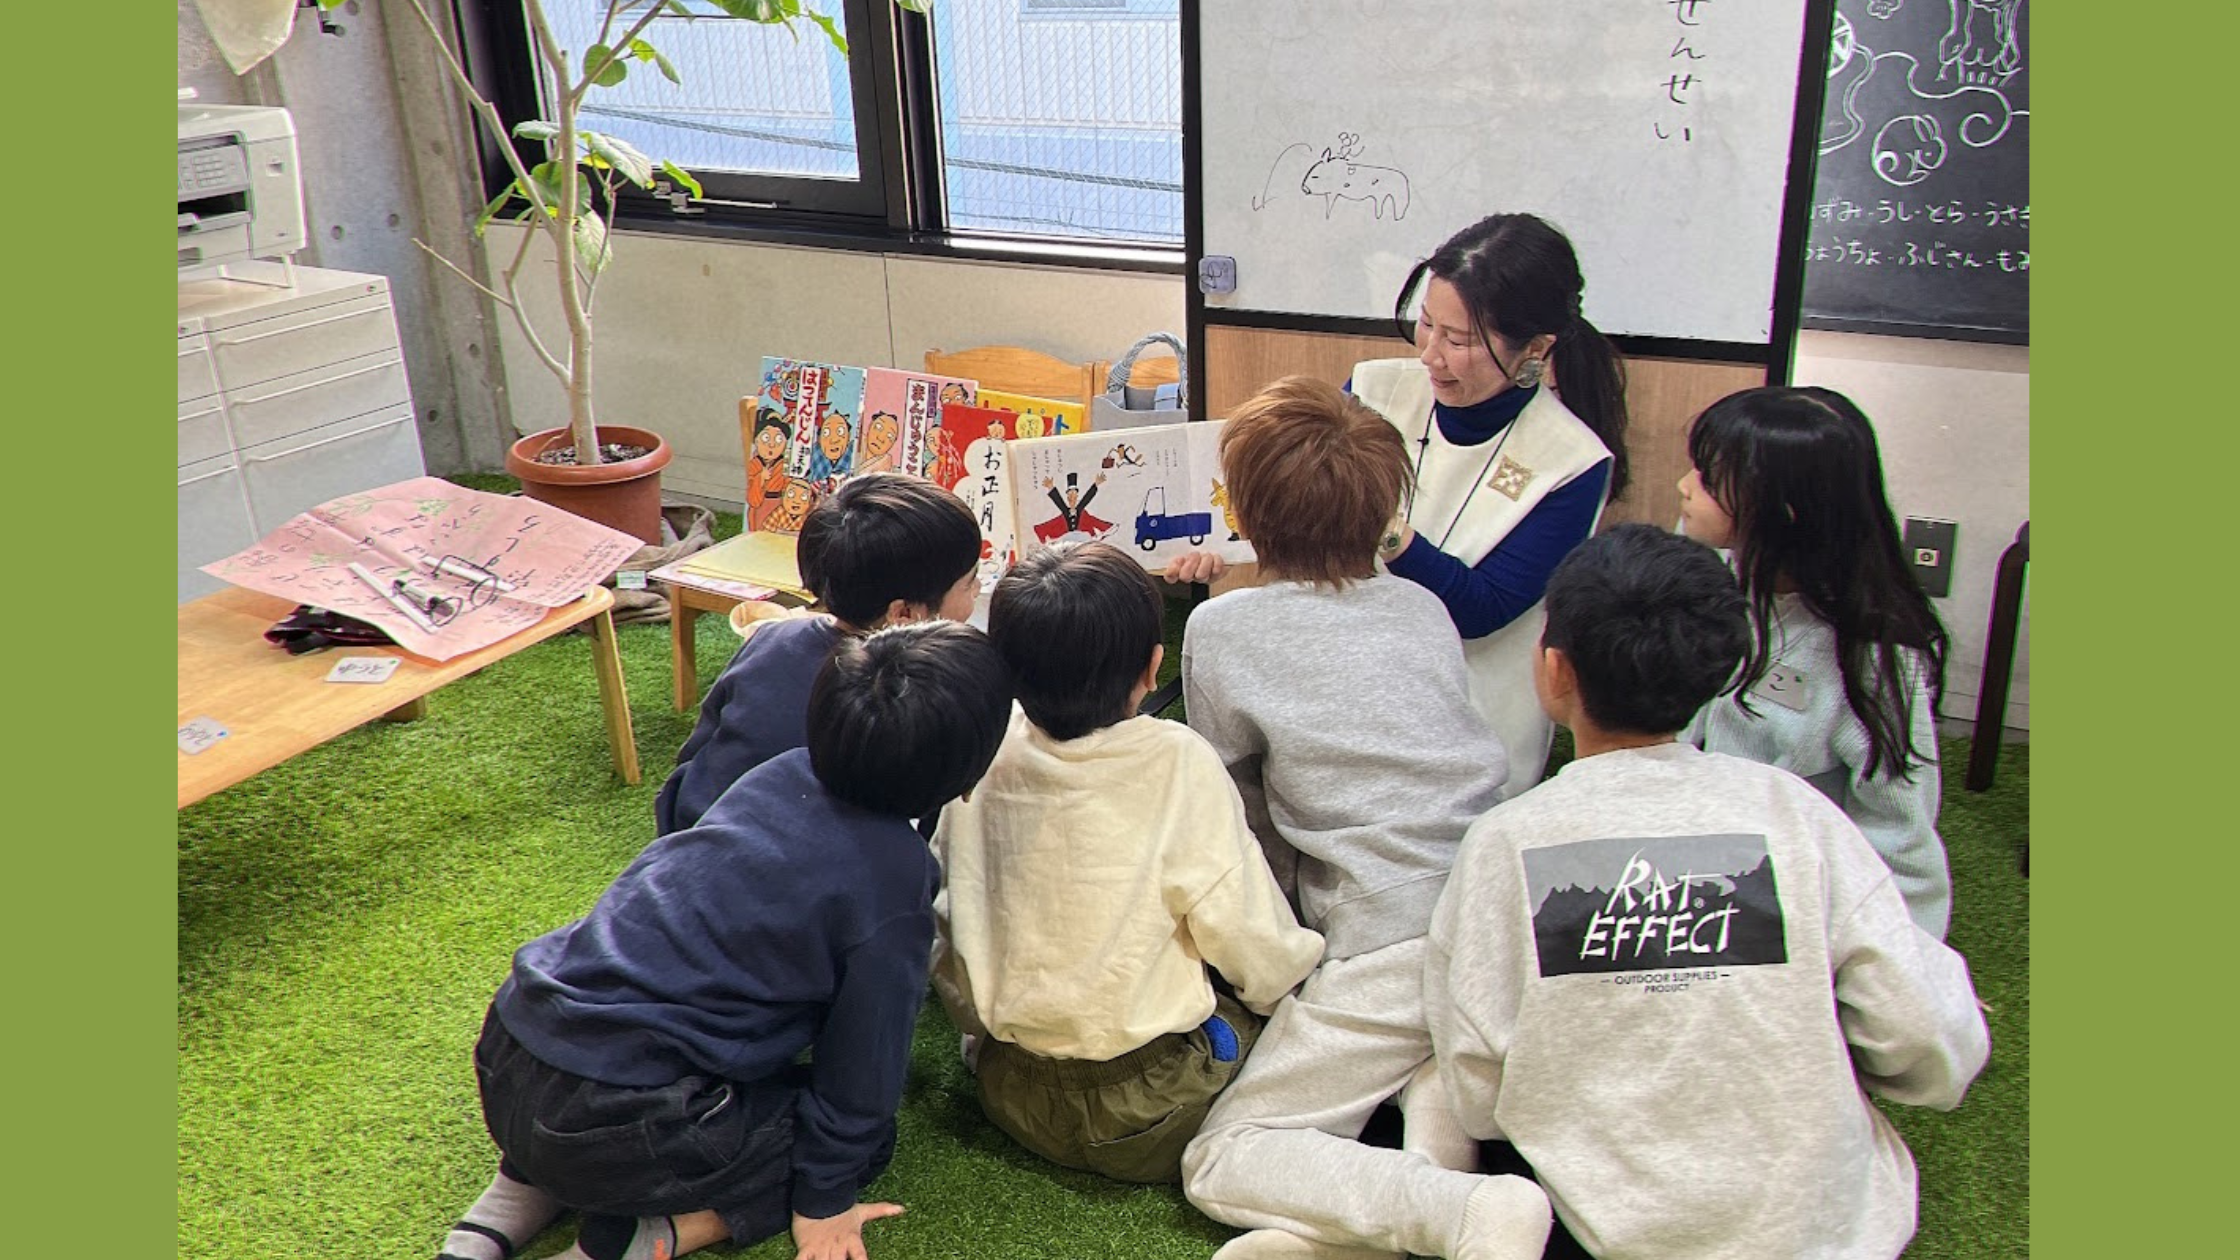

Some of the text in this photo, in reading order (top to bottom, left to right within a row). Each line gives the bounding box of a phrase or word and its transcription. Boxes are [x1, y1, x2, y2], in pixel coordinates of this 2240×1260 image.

[1654, 0, 1711, 141] せんせい
[980, 445, 1002, 532] お正月
[1605, 847, 1723, 914] RAT
[1579, 902, 1741, 961] EFFECT
[1614, 970, 1718, 985] OUTDOOR SUPPLIES
[1644, 983, 1690, 993] PRODUCT
